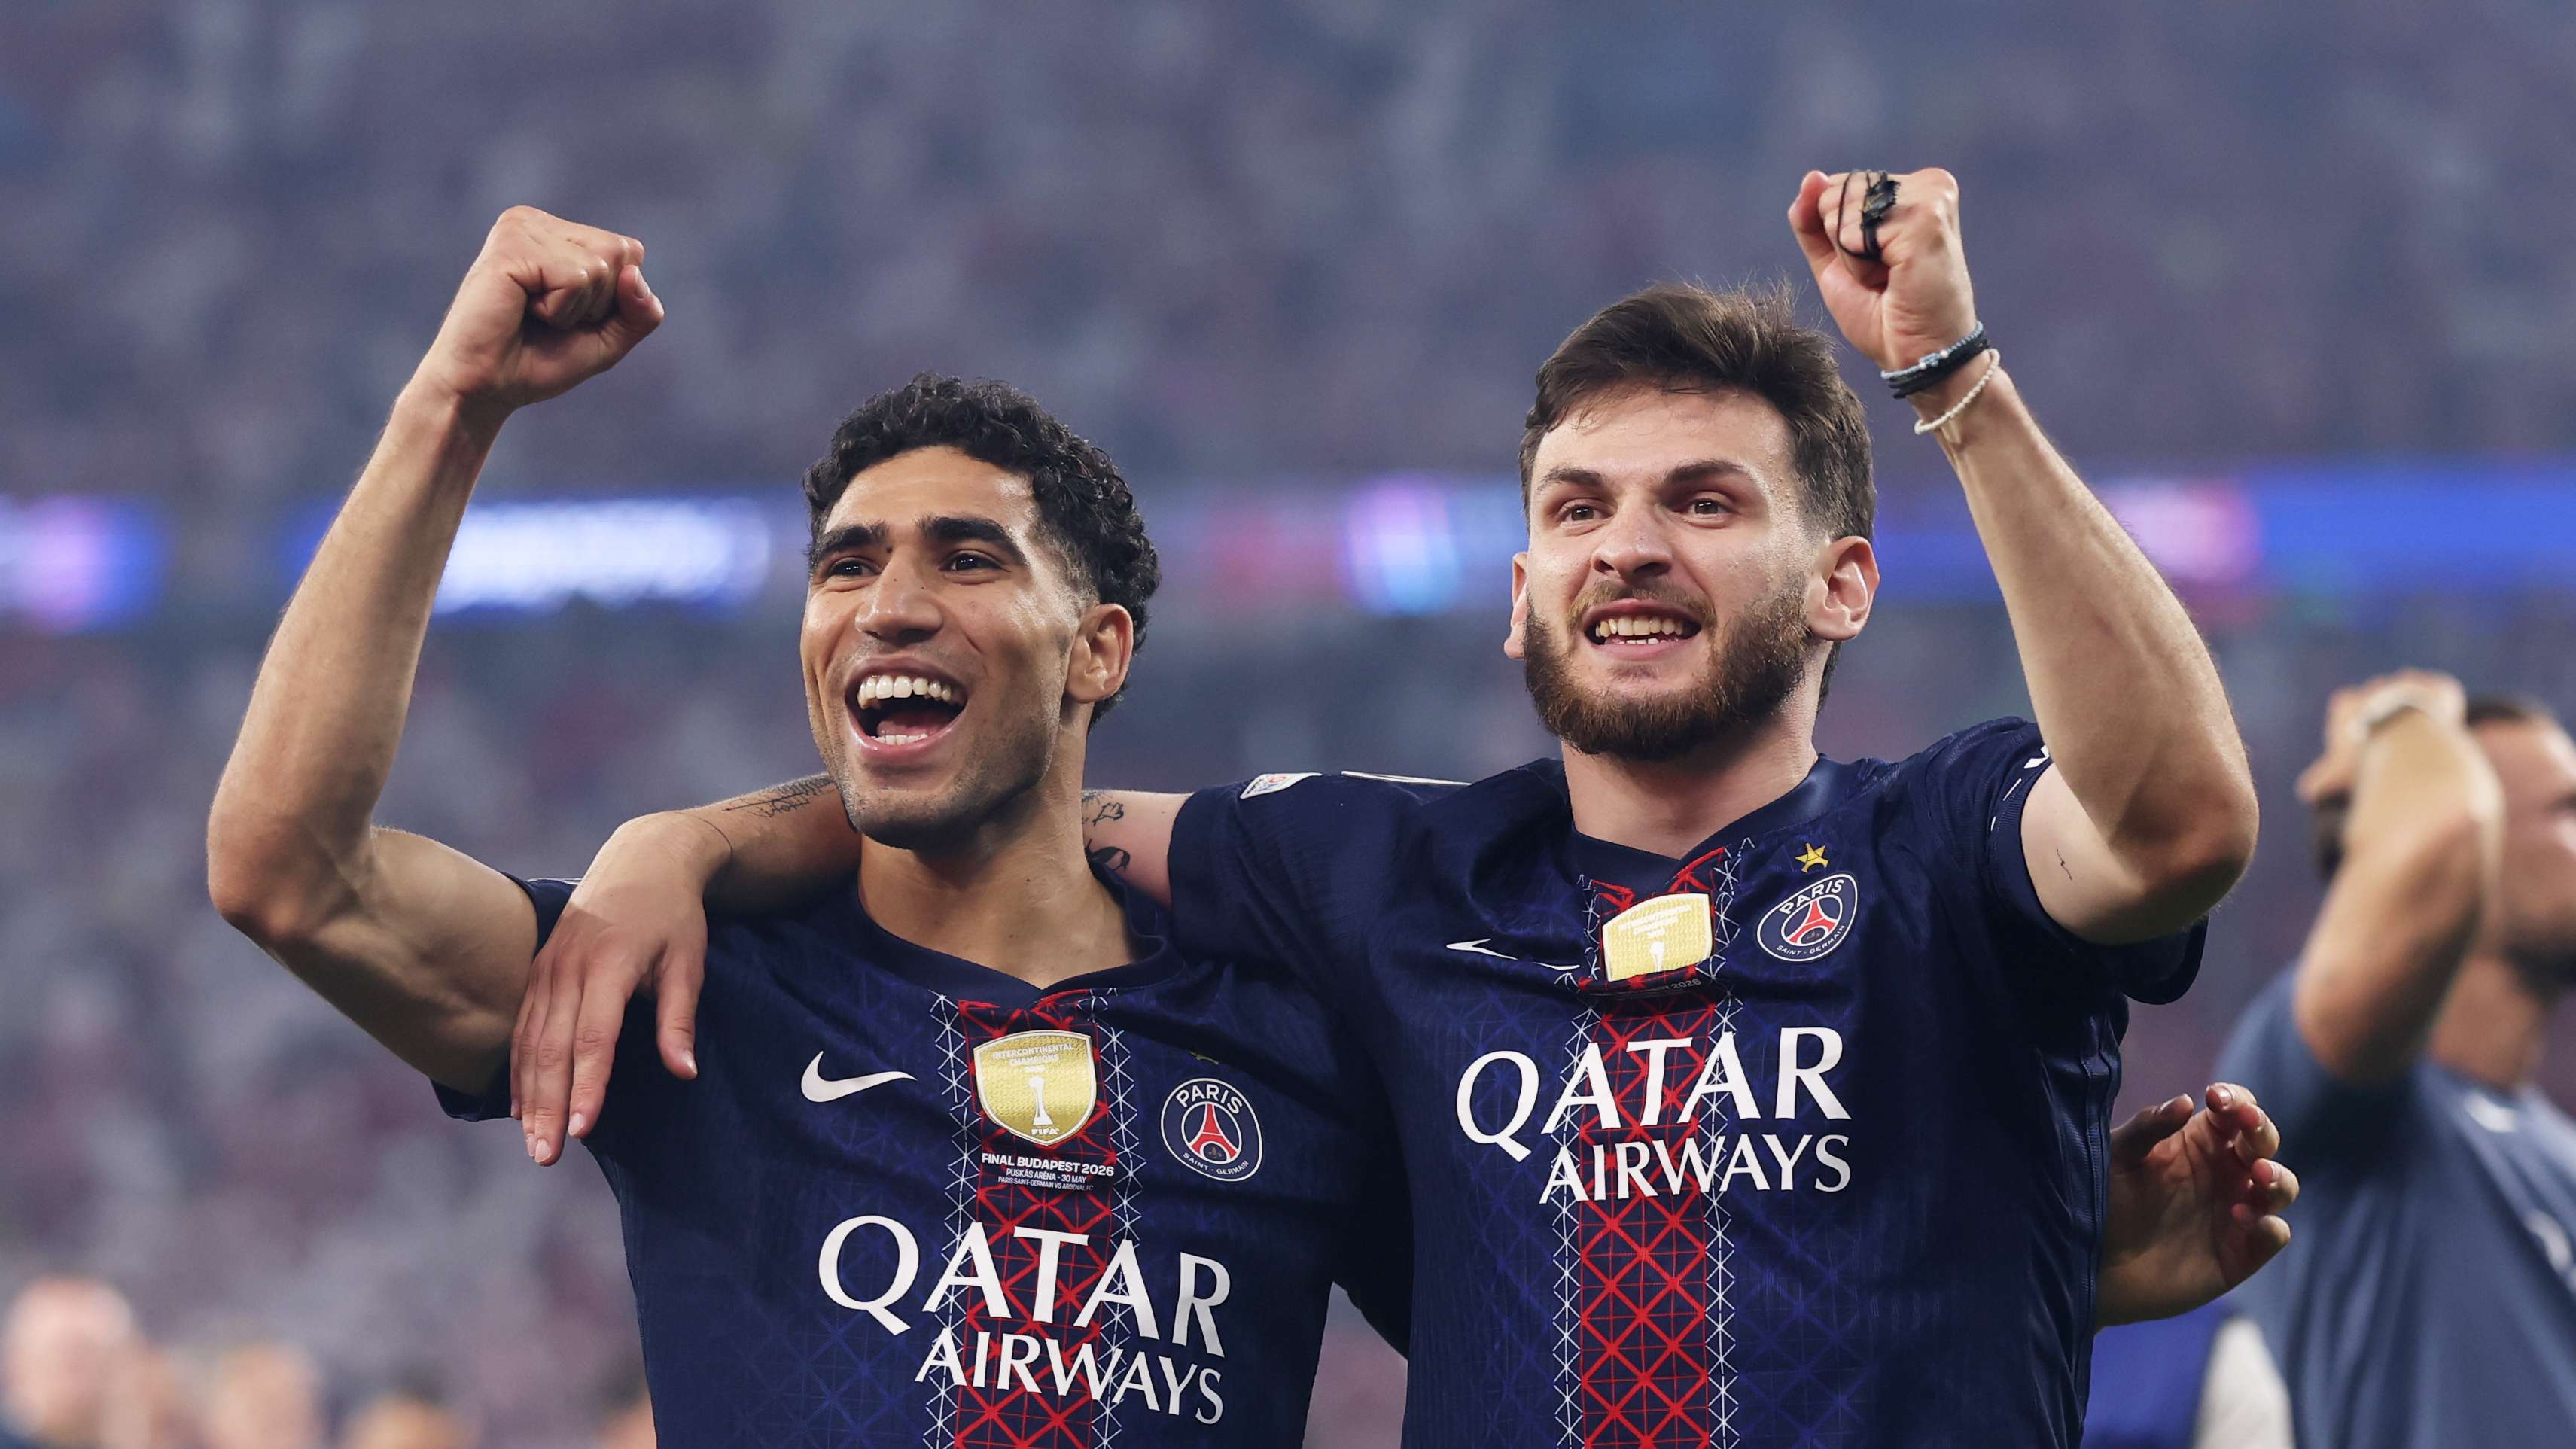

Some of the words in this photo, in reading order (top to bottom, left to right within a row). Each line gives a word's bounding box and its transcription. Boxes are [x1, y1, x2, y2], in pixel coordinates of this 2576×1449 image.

[1779, 879, 1844, 914] PARIS
[1671, 979, 1701, 989] 2026
[992, 1043, 1073, 1059] INTERCONTINENTAL
[1176, 1084, 1243, 1114] PARIS
[1457, 1027, 1852, 1162] QATAR
[1031, 1128, 1058, 1137] FIFA
[981, 1152, 1015, 1166] FINAL
[1016, 1156, 1080, 1173] BUDAPEST
[1082, 1164, 1114, 1177] 2026
[1006, 1167, 1034, 1178] PUSKÁS
[1034, 1170, 1056, 1180] ARÉNA
[1061, 1174, 1070, 1183] 30
[1071, 1175, 1086, 1183] MAY
[1539, 1133, 1851, 1204] AIRWAYS
[997, 1176, 1013, 1184] PARIS
[1013, 1178, 1054, 1188] SAINT-GERMAIN
[818, 1215, 1231, 1358] QATAR
[914, 1327, 1223, 1425] AIRWAYS
